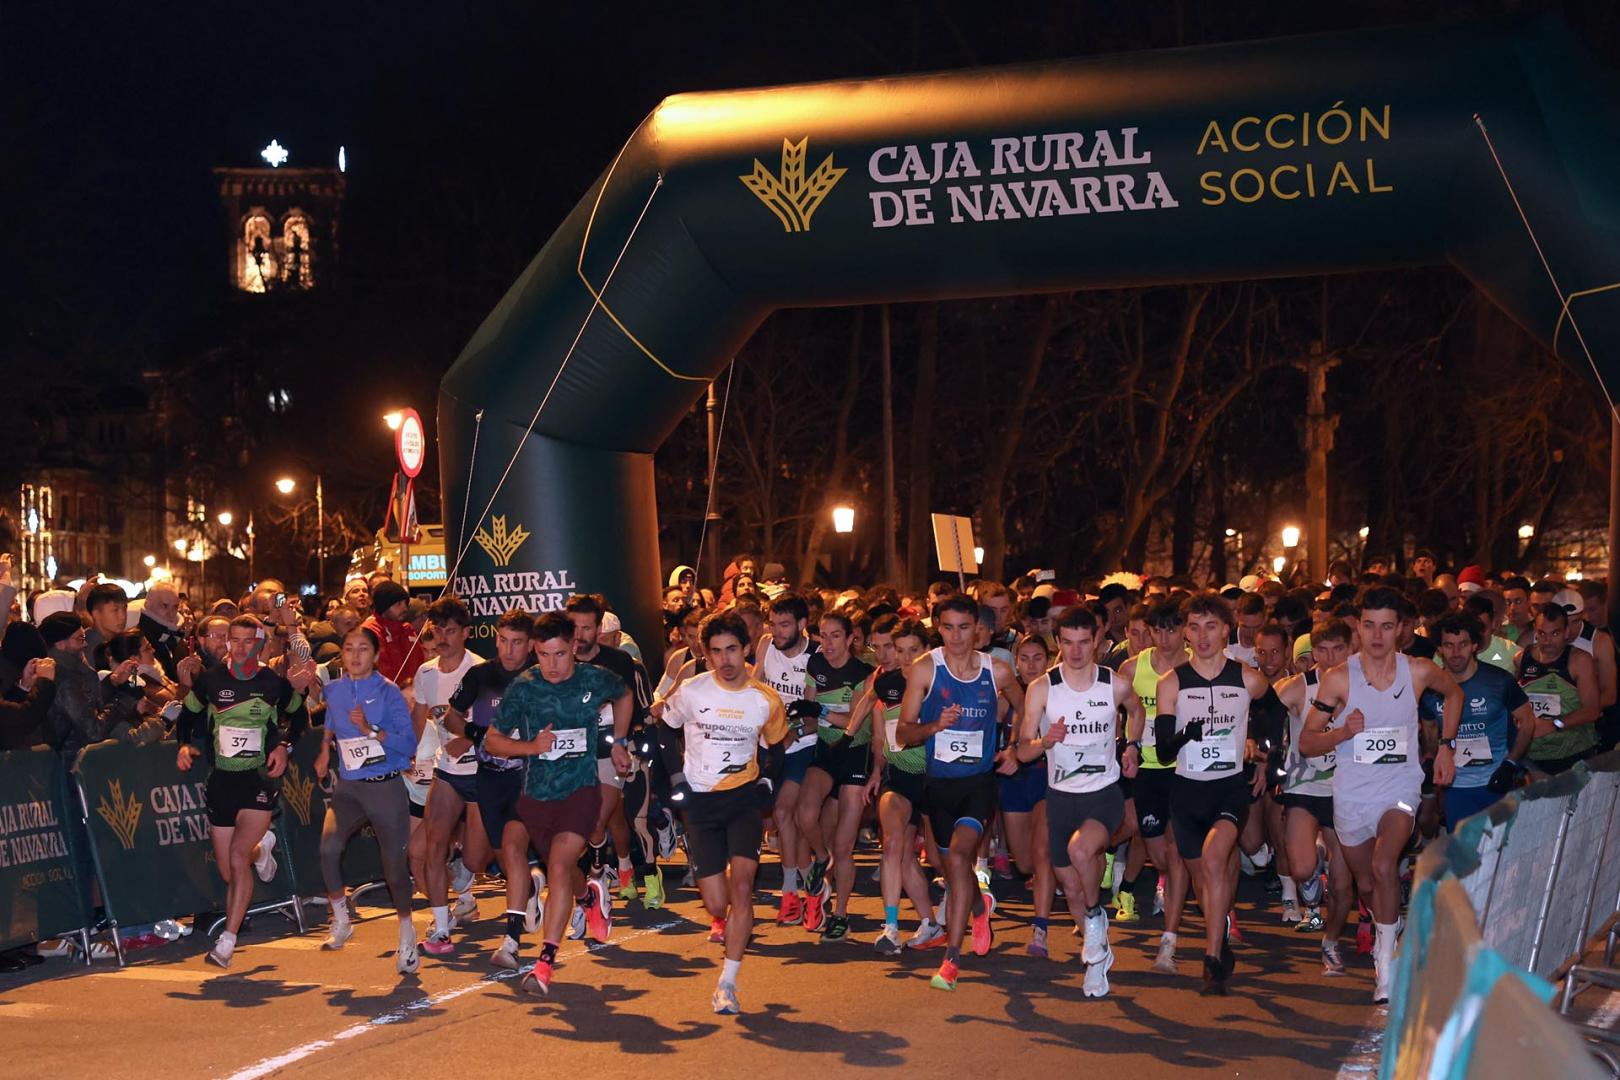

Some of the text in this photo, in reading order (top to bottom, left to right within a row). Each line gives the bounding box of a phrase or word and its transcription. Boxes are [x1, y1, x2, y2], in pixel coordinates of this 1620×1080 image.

[1196, 100, 1391, 155] ACCIÓN
[868, 126, 1152, 185] CAJA RURAL
[1199, 157, 1394, 206] SOCIAL
[868, 171, 1180, 228] DE NAVARRA
[493, 570, 576, 594] RURAL
[473, 592, 576, 617] NAVARR
[468, 622, 499, 639] CIÓN
[1065, 721, 1109, 734] renike
[1457, 722, 1486, 733] ntro
[231, 737, 248, 748] 37
[552, 739, 575, 750] 123
[950, 740, 968, 753] 63
[1365, 738, 1397, 752] 209
[348, 745, 370, 759] 187
[722, 751, 731, 762] 2
[1074, 751, 1084, 762] 7
[1201, 747, 1221, 759] 85
[1462, 747, 1473, 757] 4
[150, 783, 197, 814] CAJA
[16, 800, 59, 831] RURAL
[156, 815, 184, 846] DE
[10, 831, 69, 865] NAVARRA
